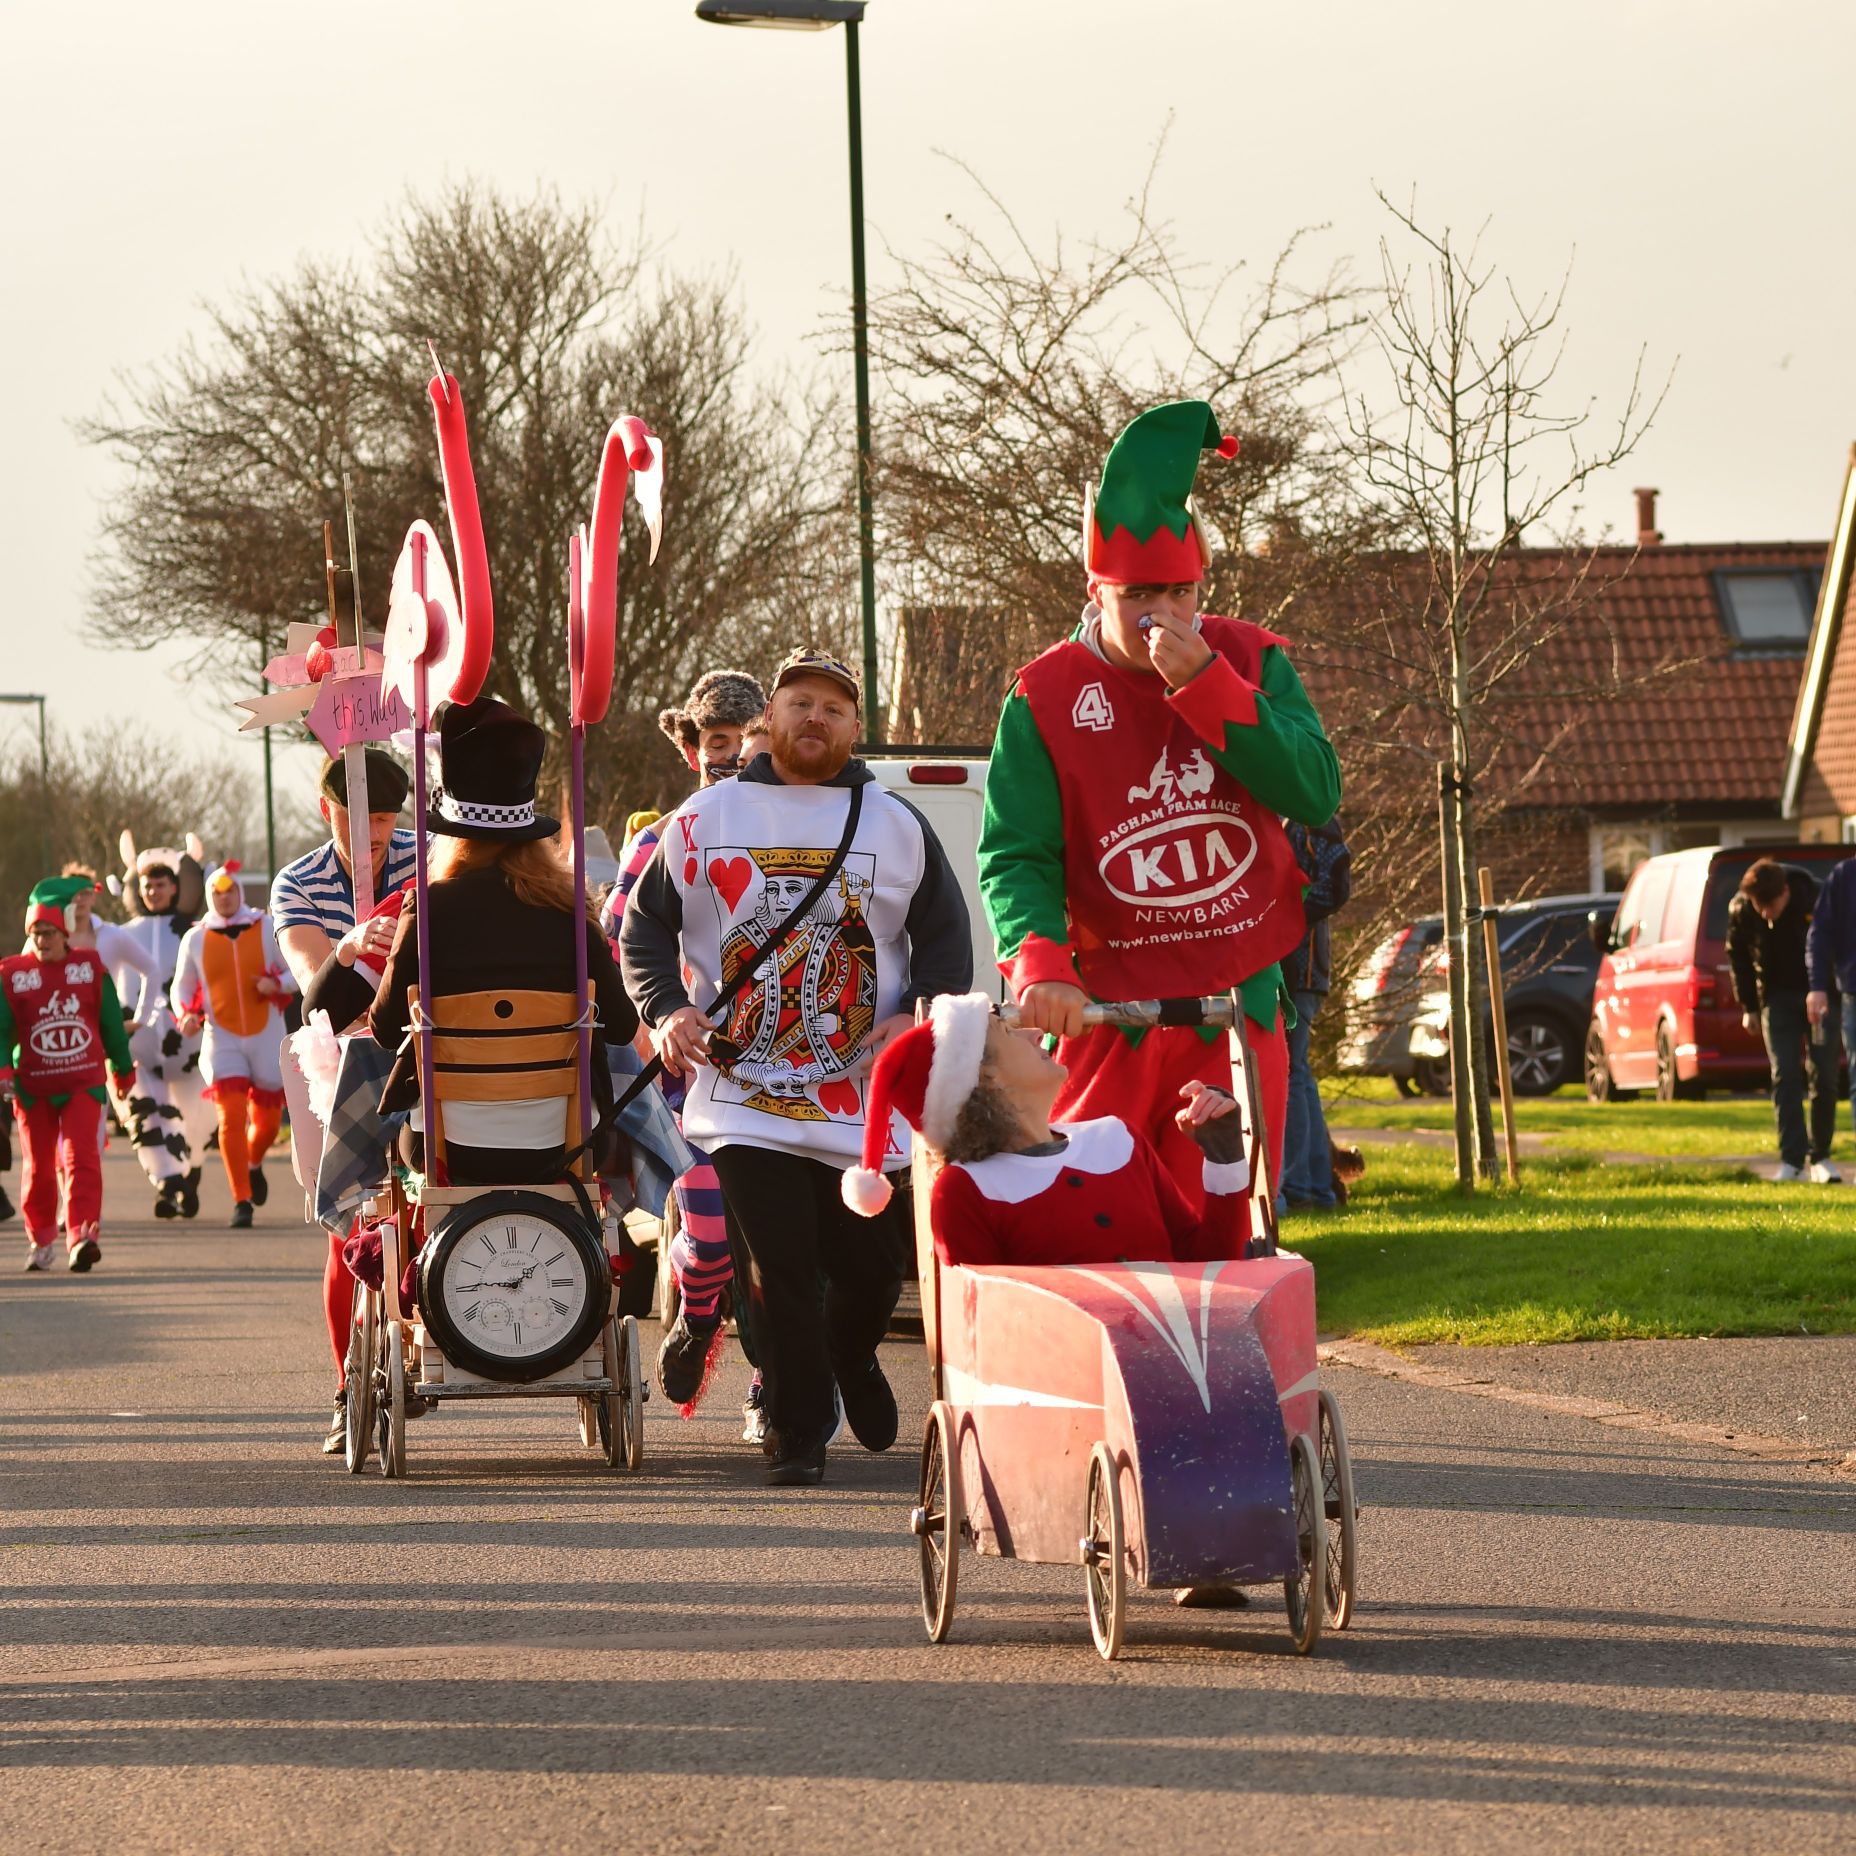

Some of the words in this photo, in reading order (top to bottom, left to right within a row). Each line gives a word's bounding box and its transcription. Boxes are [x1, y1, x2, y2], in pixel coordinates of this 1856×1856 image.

[333, 692, 365, 732] this
[1071, 681, 1115, 732] 4
[677, 813, 699, 852] K
[1099, 807, 1165, 849] PAGHAM
[1167, 799, 1208, 816] PRAM
[1127, 828, 1238, 892] KIA
[1135, 885, 1250, 924] NEWBARN
[11, 967, 43, 994] 24
[65, 960, 95, 985] 24
[40, 1027, 85, 1050] KIA
[551, 1278, 574, 1288] III
